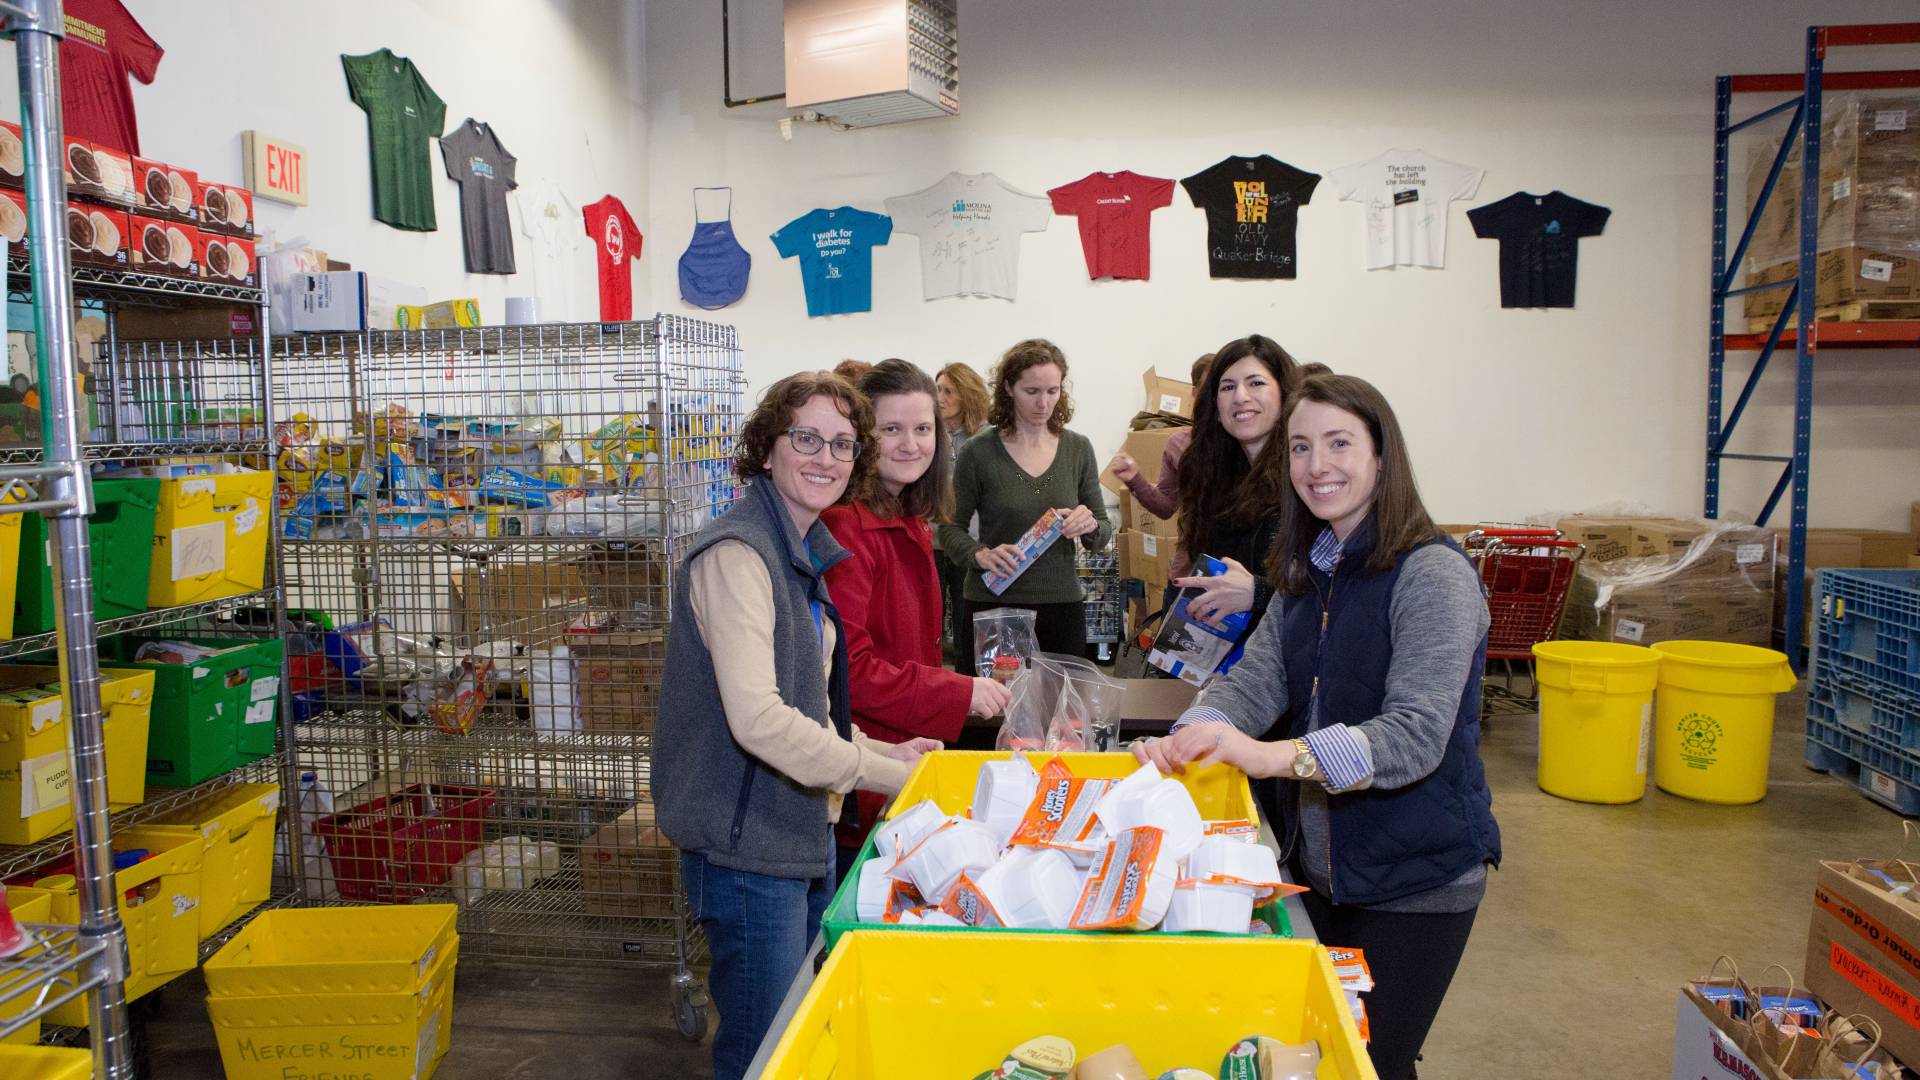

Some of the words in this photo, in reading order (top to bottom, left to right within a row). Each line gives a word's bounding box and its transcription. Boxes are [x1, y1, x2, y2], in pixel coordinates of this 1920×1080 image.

[64, 23, 106, 47] OMMUNITY
[267, 144, 301, 194] EXIT
[812, 233, 816, 241] I
[817, 229, 838, 240] walk
[839, 228, 853, 238] for
[1235, 233, 1269, 246] NAVY
[1239, 223, 1265, 234] OLD
[816, 238, 851, 248] diabetes
[820, 249, 830, 257] Do
[830, 248, 847, 257] you?
[46, 768, 69, 785] PUDDI
[1040, 788, 1057, 813] Honey
[1046, 779, 1070, 823] Scooters
[1117, 861, 1138, 916] Scooters
[1840, 906, 1880, 940] Order
[1882, 935, 1920, 970] omer
[237, 1037, 334, 1063] MERCER
